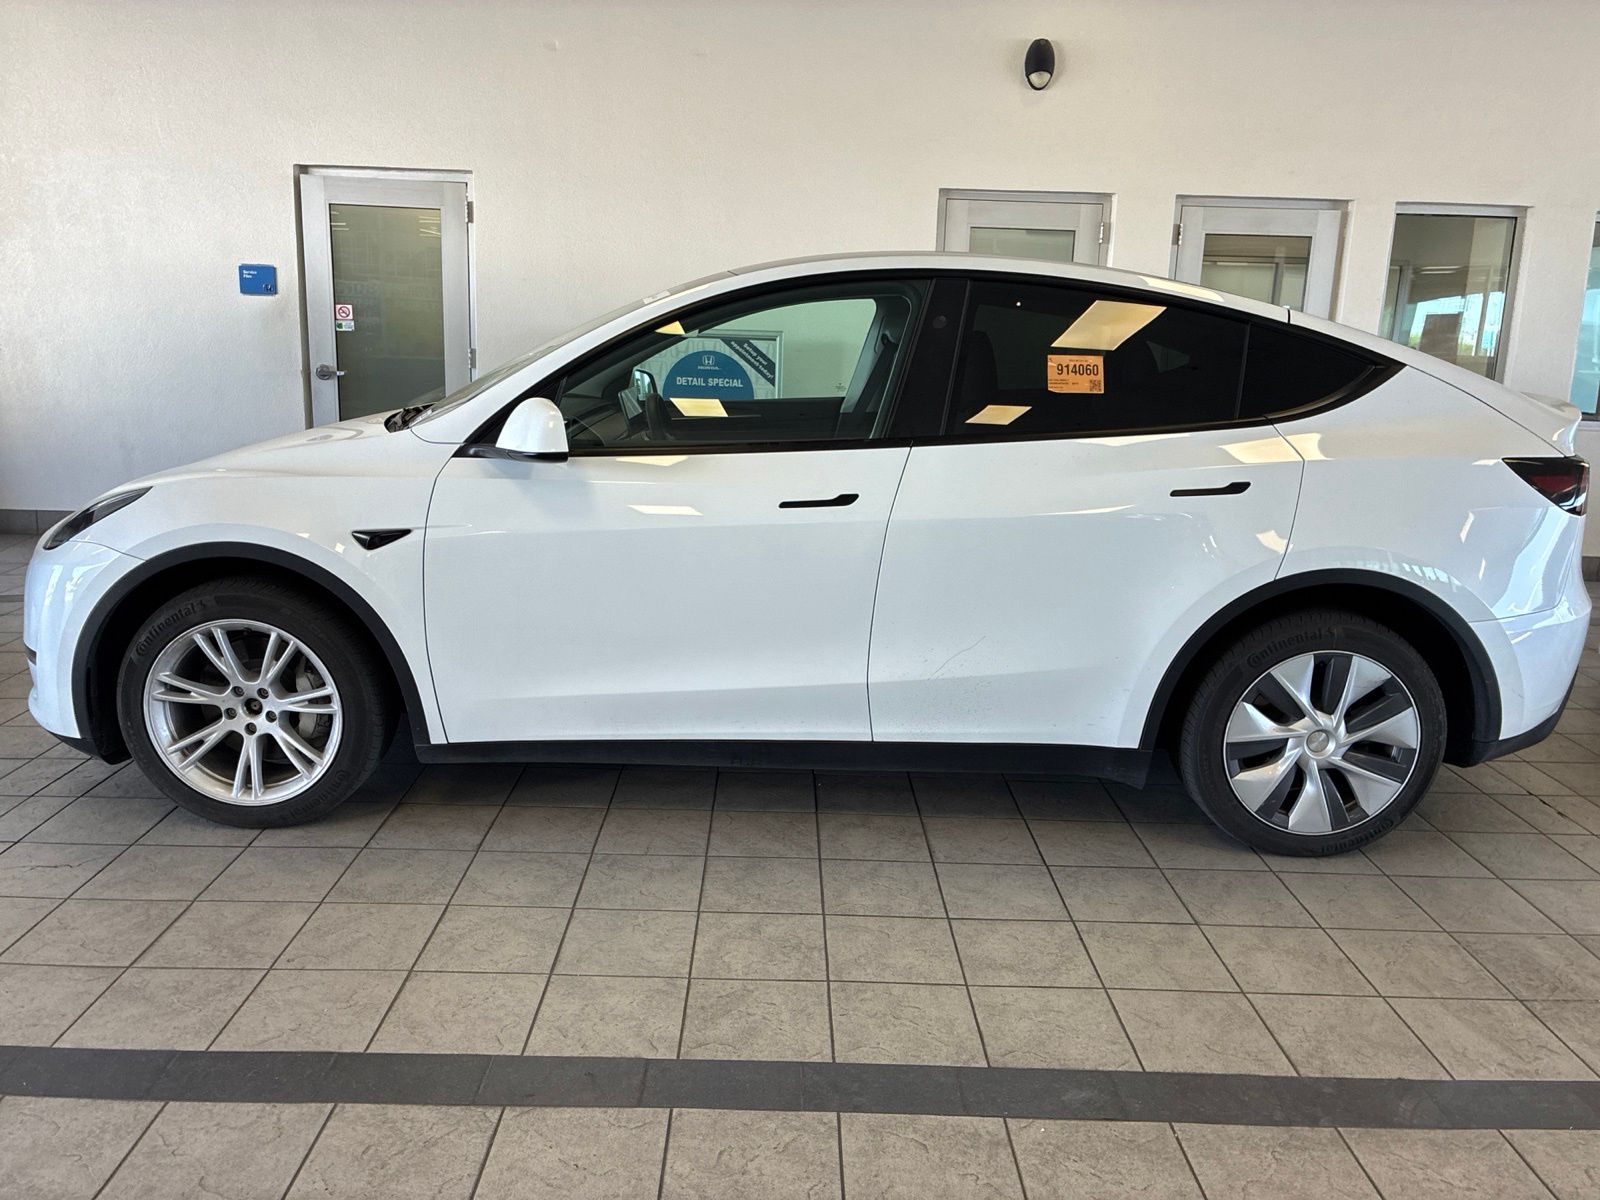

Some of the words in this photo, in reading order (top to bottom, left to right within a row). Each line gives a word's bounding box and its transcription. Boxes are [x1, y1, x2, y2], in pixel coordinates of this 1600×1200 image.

[676, 376, 705, 386] DETAIL
[708, 378, 743, 388] SPECIAL
[1057, 363, 1099, 376] 914060
[135, 602, 196, 657] Continental
[1246, 628, 1322, 668] Continental
